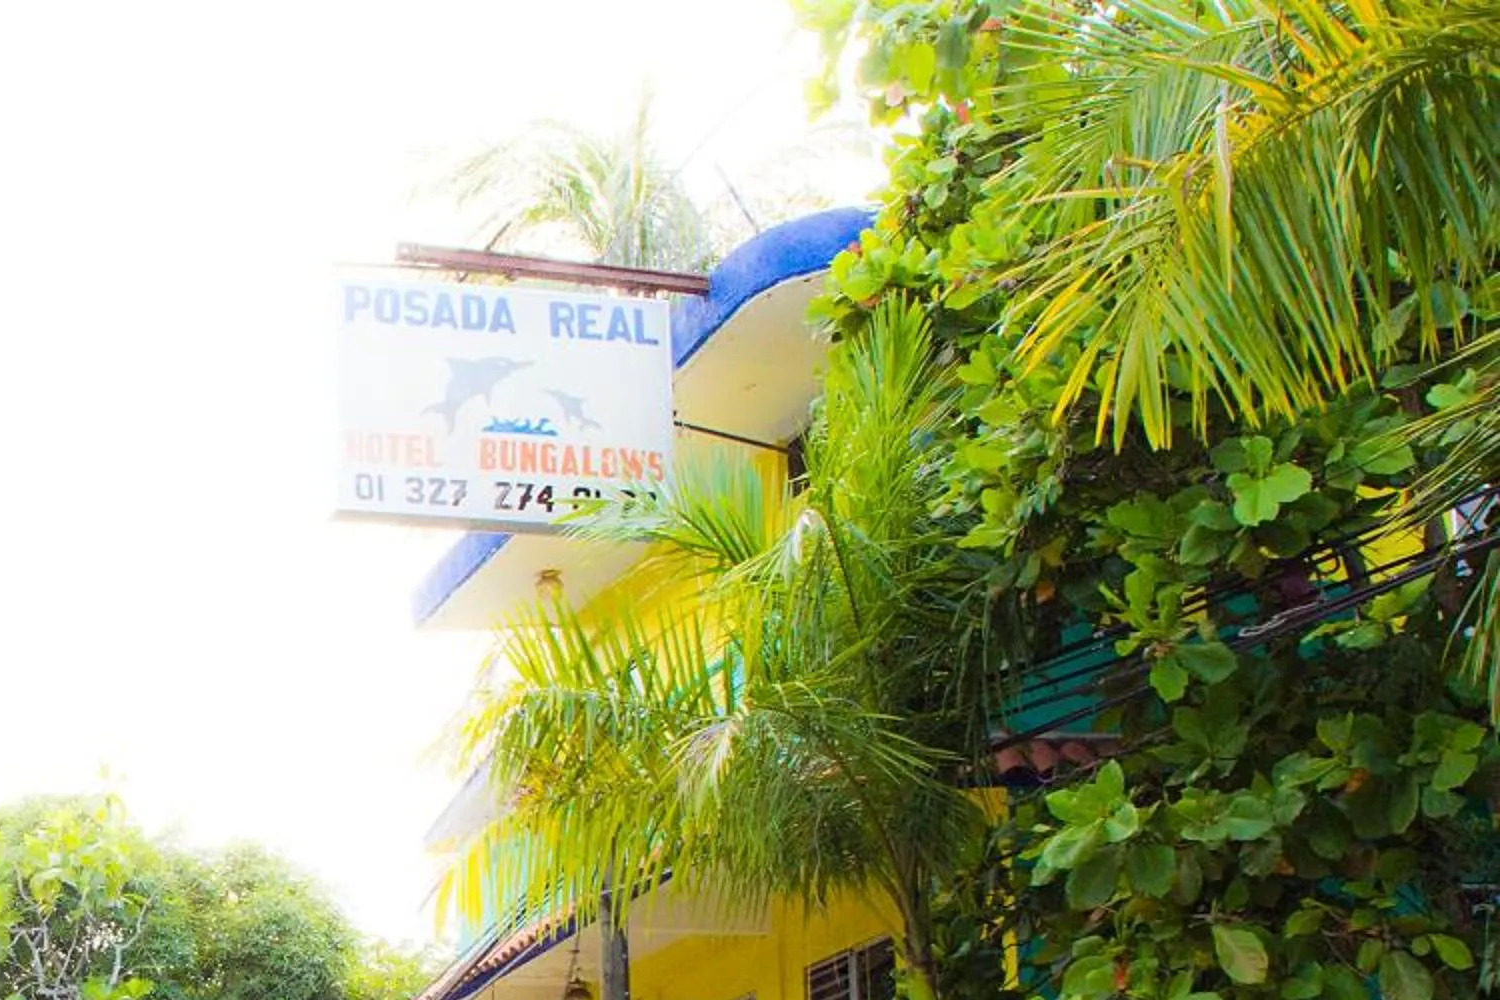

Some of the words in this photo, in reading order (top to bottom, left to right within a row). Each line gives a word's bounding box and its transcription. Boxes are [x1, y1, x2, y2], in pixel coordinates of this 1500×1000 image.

[343, 285, 517, 334] POSADA
[549, 301, 660, 346] REAL
[345, 429, 442, 468] HOTEL
[479, 437, 665, 482] BUNGALOWS
[355, 474, 384, 502] 01
[405, 477, 468, 507] 327
[494, 481, 555, 513] 274
